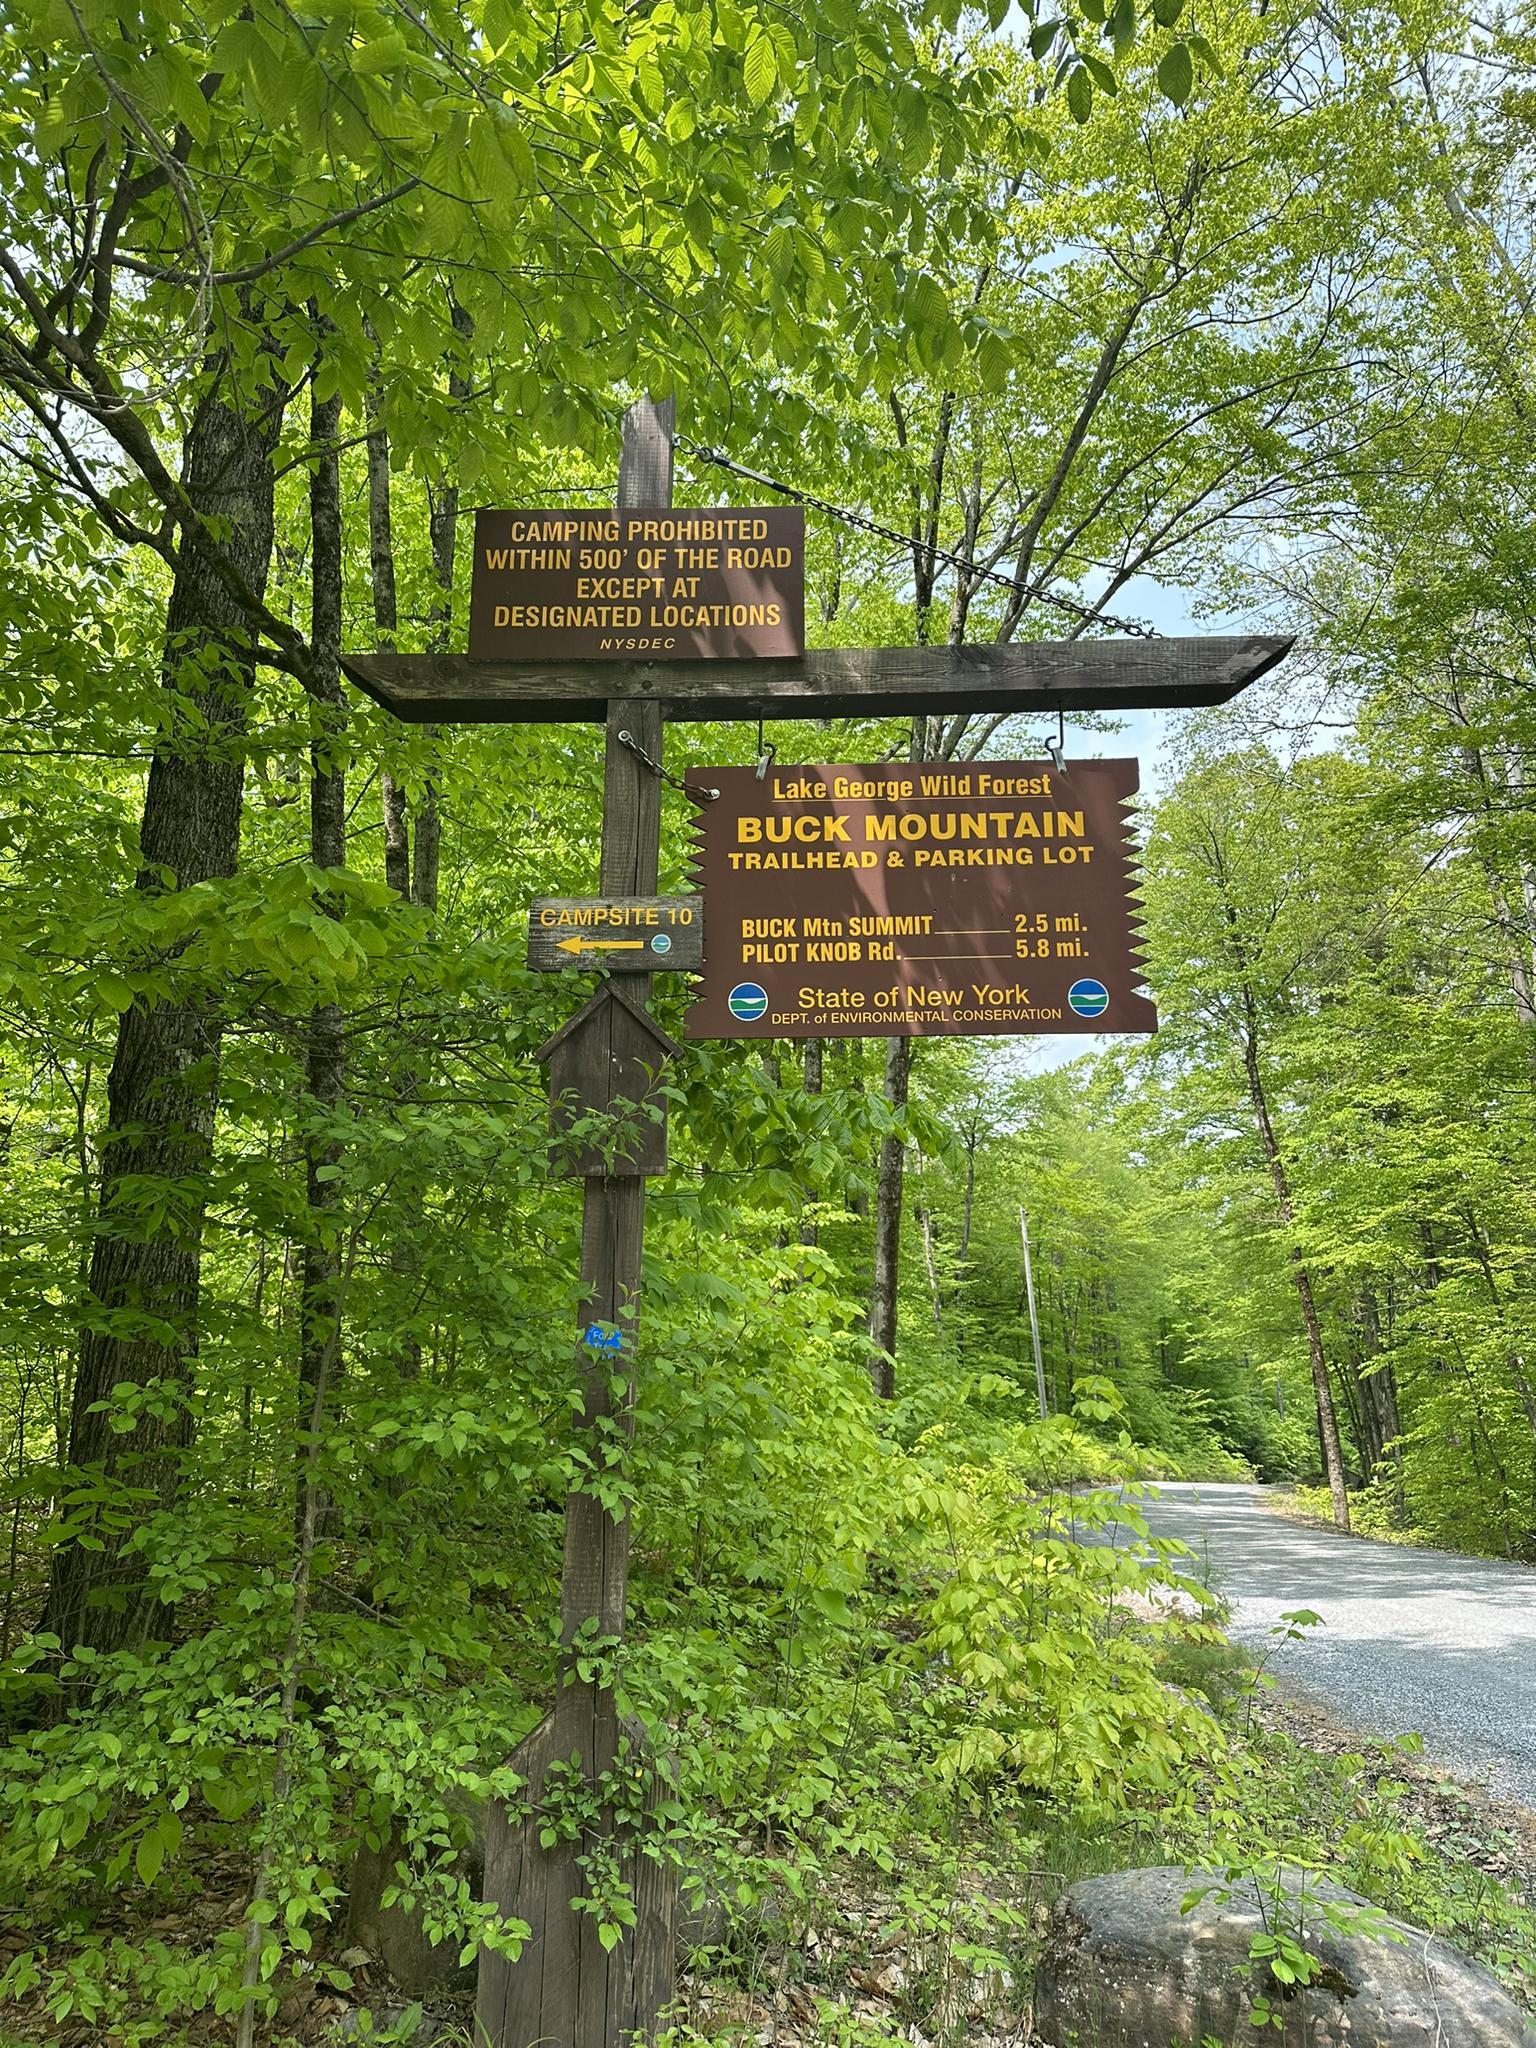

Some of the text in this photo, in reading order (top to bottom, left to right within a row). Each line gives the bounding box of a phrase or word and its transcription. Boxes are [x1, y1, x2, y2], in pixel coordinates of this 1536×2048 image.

[511, 519, 768, 542] CAMPING PROHIBITED
[485, 549, 571, 570] WITHIN
[637, 549, 666, 570] OF
[674, 548, 718, 569] THE
[727, 547, 792, 569] ROAD
[576, 577, 700, 599] EXCEPT AT
[494, 604, 780, 627] DESIGNATED LOCATIONS
[599, 637, 675, 650] NYSDEC
[773, 774, 1051, 801] Lake George Wild Forest
[737, 811, 1085, 843] BUCK MOUNTAIN
[728, 845, 1094, 870] TRAILHEAD & PARKING LOT
[540, 908, 693, 927] CAMPSITE 10
[742, 914, 1088, 939] BUCK Mtn SUMMIT 2.5 mi.
[742, 938, 1089, 963] PILOT KNOB Rd. 5.8 mi.
[797, 984, 1030, 1008] State of New York
[771, 1008, 1063, 1025] DEPT. of ENVIRONMENTAL CONSERVATION
